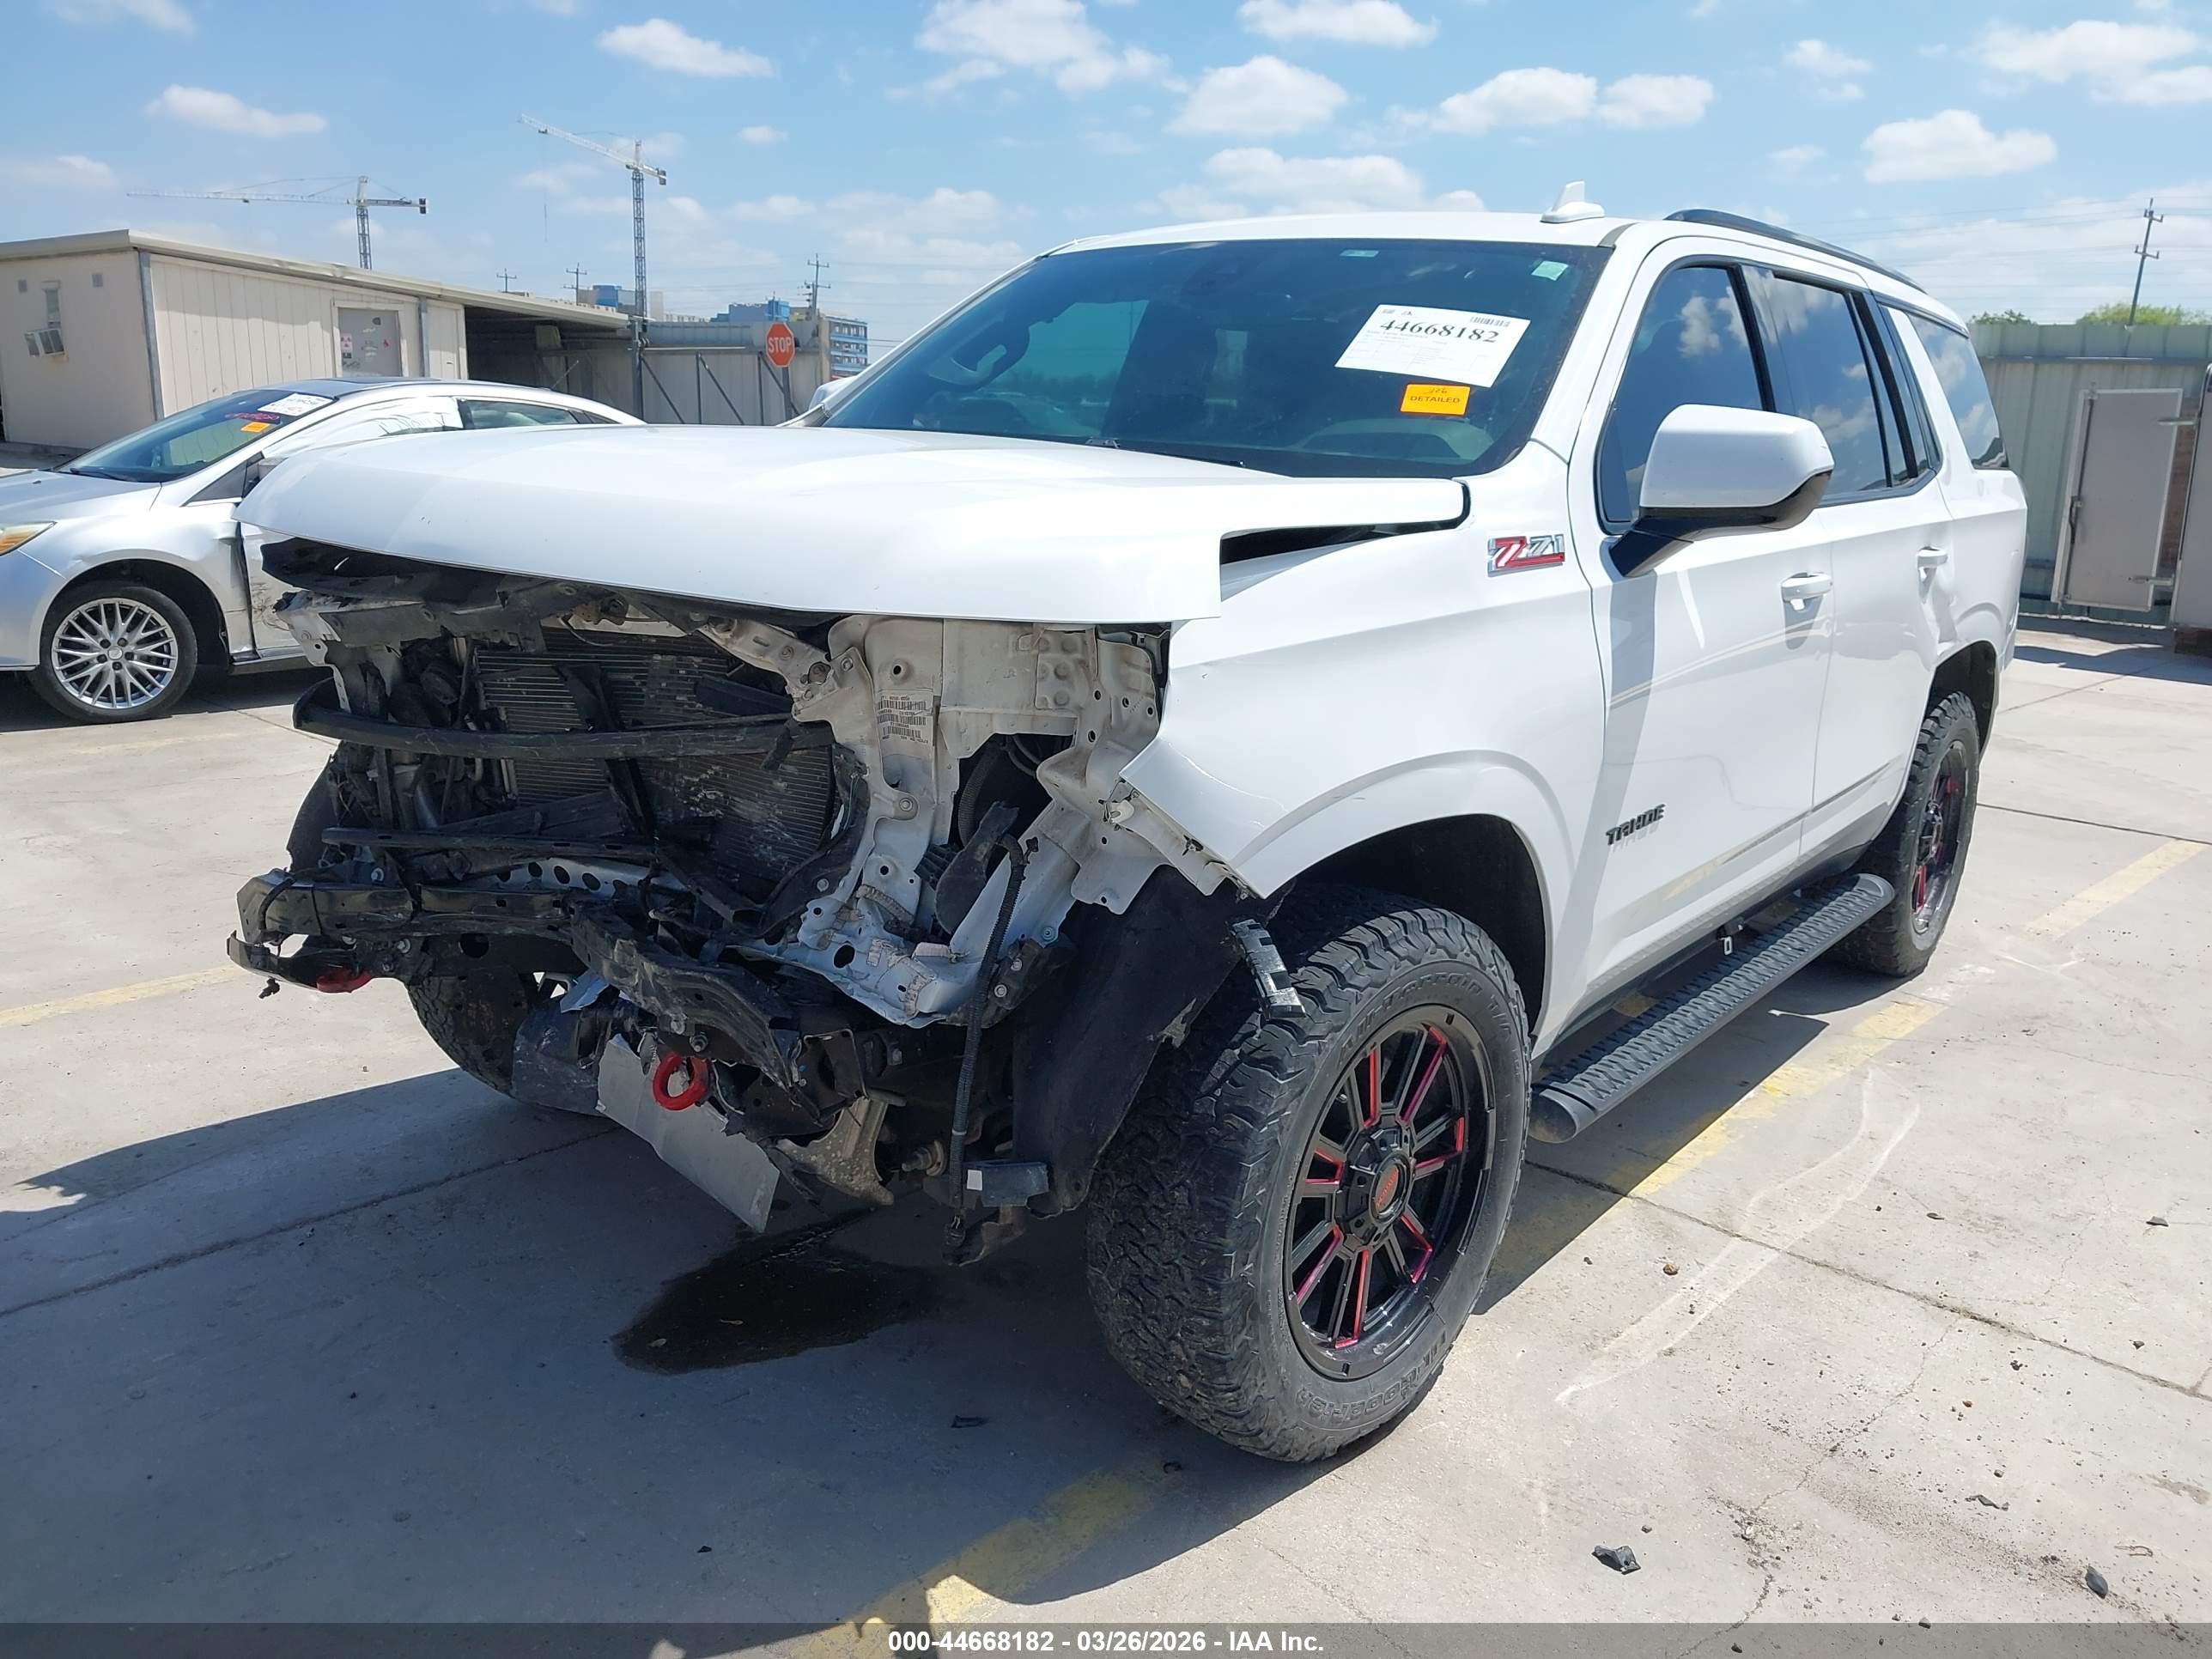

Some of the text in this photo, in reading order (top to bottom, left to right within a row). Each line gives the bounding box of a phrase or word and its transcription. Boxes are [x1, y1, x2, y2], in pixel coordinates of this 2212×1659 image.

[1381, 319, 1499, 343] 44668182
[769, 337, 792, 353] STOP
[1605, 804, 1666, 845] TAHOE
